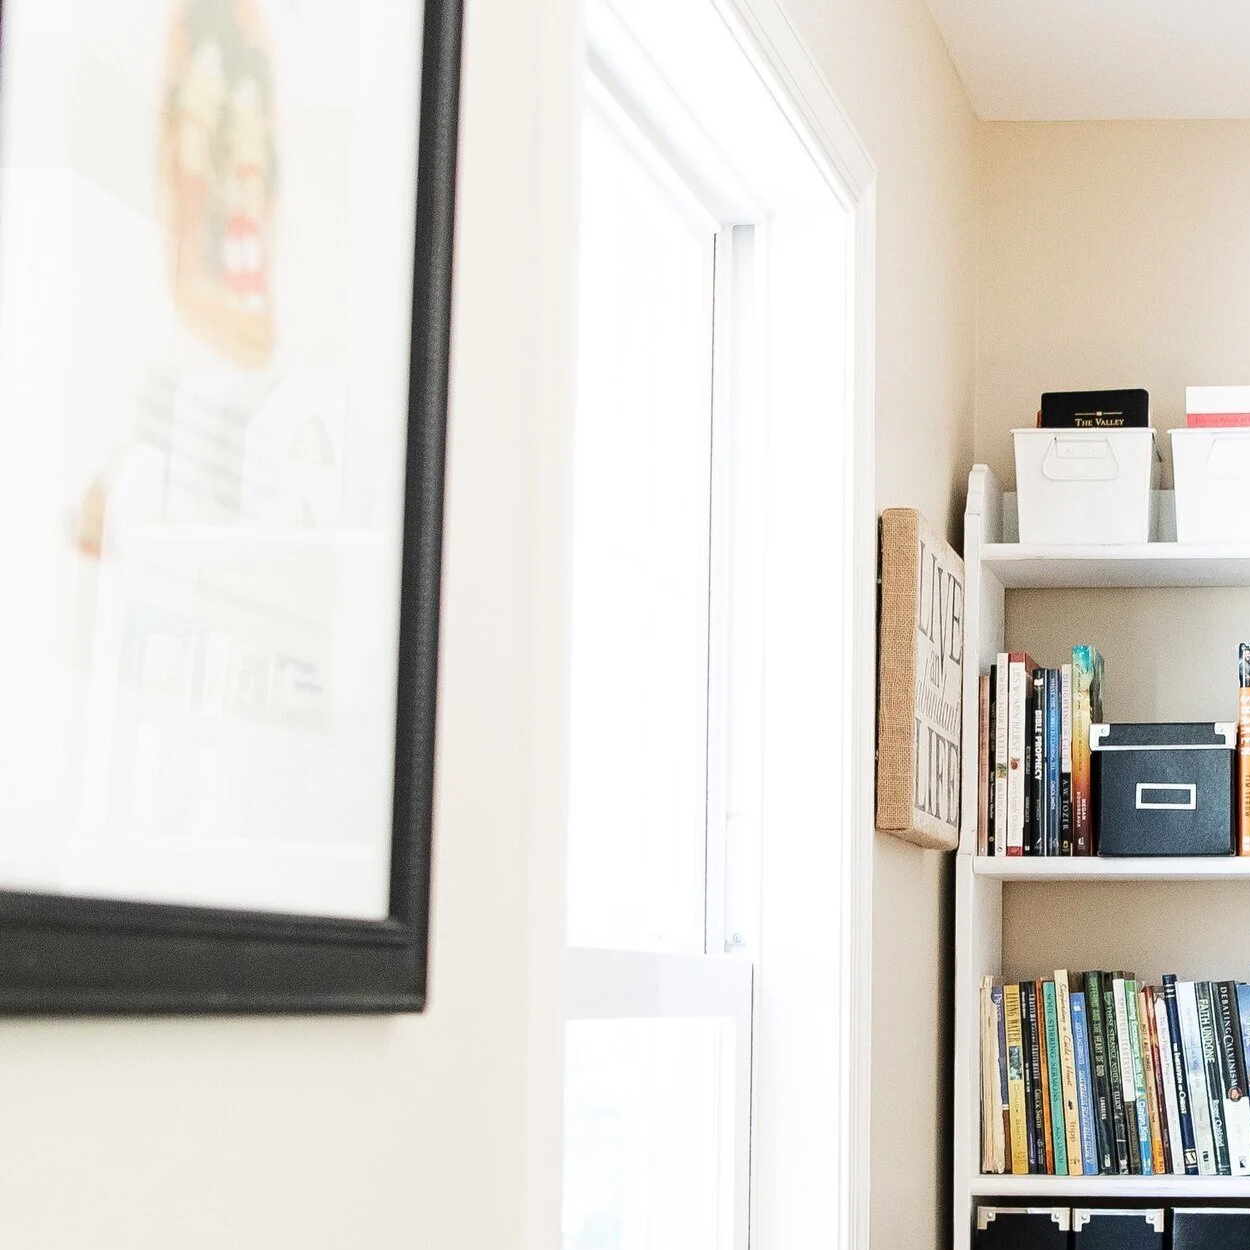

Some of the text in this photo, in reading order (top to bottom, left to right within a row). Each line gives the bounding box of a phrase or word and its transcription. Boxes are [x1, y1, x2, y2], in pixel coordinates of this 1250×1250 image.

[1074, 417, 1125, 427] THE VALLEY
[917, 539, 963, 677] LIVE
[1034, 710, 1043, 780] BIBLE PROPHECY
[914, 717, 960, 828] LIFE
[1062, 800, 1070, 830] TOZER
[1005, 991, 1020, 1019] LIVING
[1199, 998, 1210, 1025] FAITH
[1007, 1019, 1021, 1043] WATER
[1047, 1017, 1056, 1058] STIRRING
[1094, 1035, 1102, 1053] HEART
[1109, 1029, 1117, 1060] STRANGE
[1202, 1026, 1215, 1063] UNDONE
[1220, 986, 1237, 1086] DEBATING CALVINISM
[1095, 1055, 1103, 1063] OF
[1096, 1064, 1105, 1077] GOD
[1128, 990, 1149, 1142] Amazing Encounters with God Clayton King
[1050, 1062, 1059, 1102] SERMONS
[1069, 1121, 1077, 1143] Tripp
